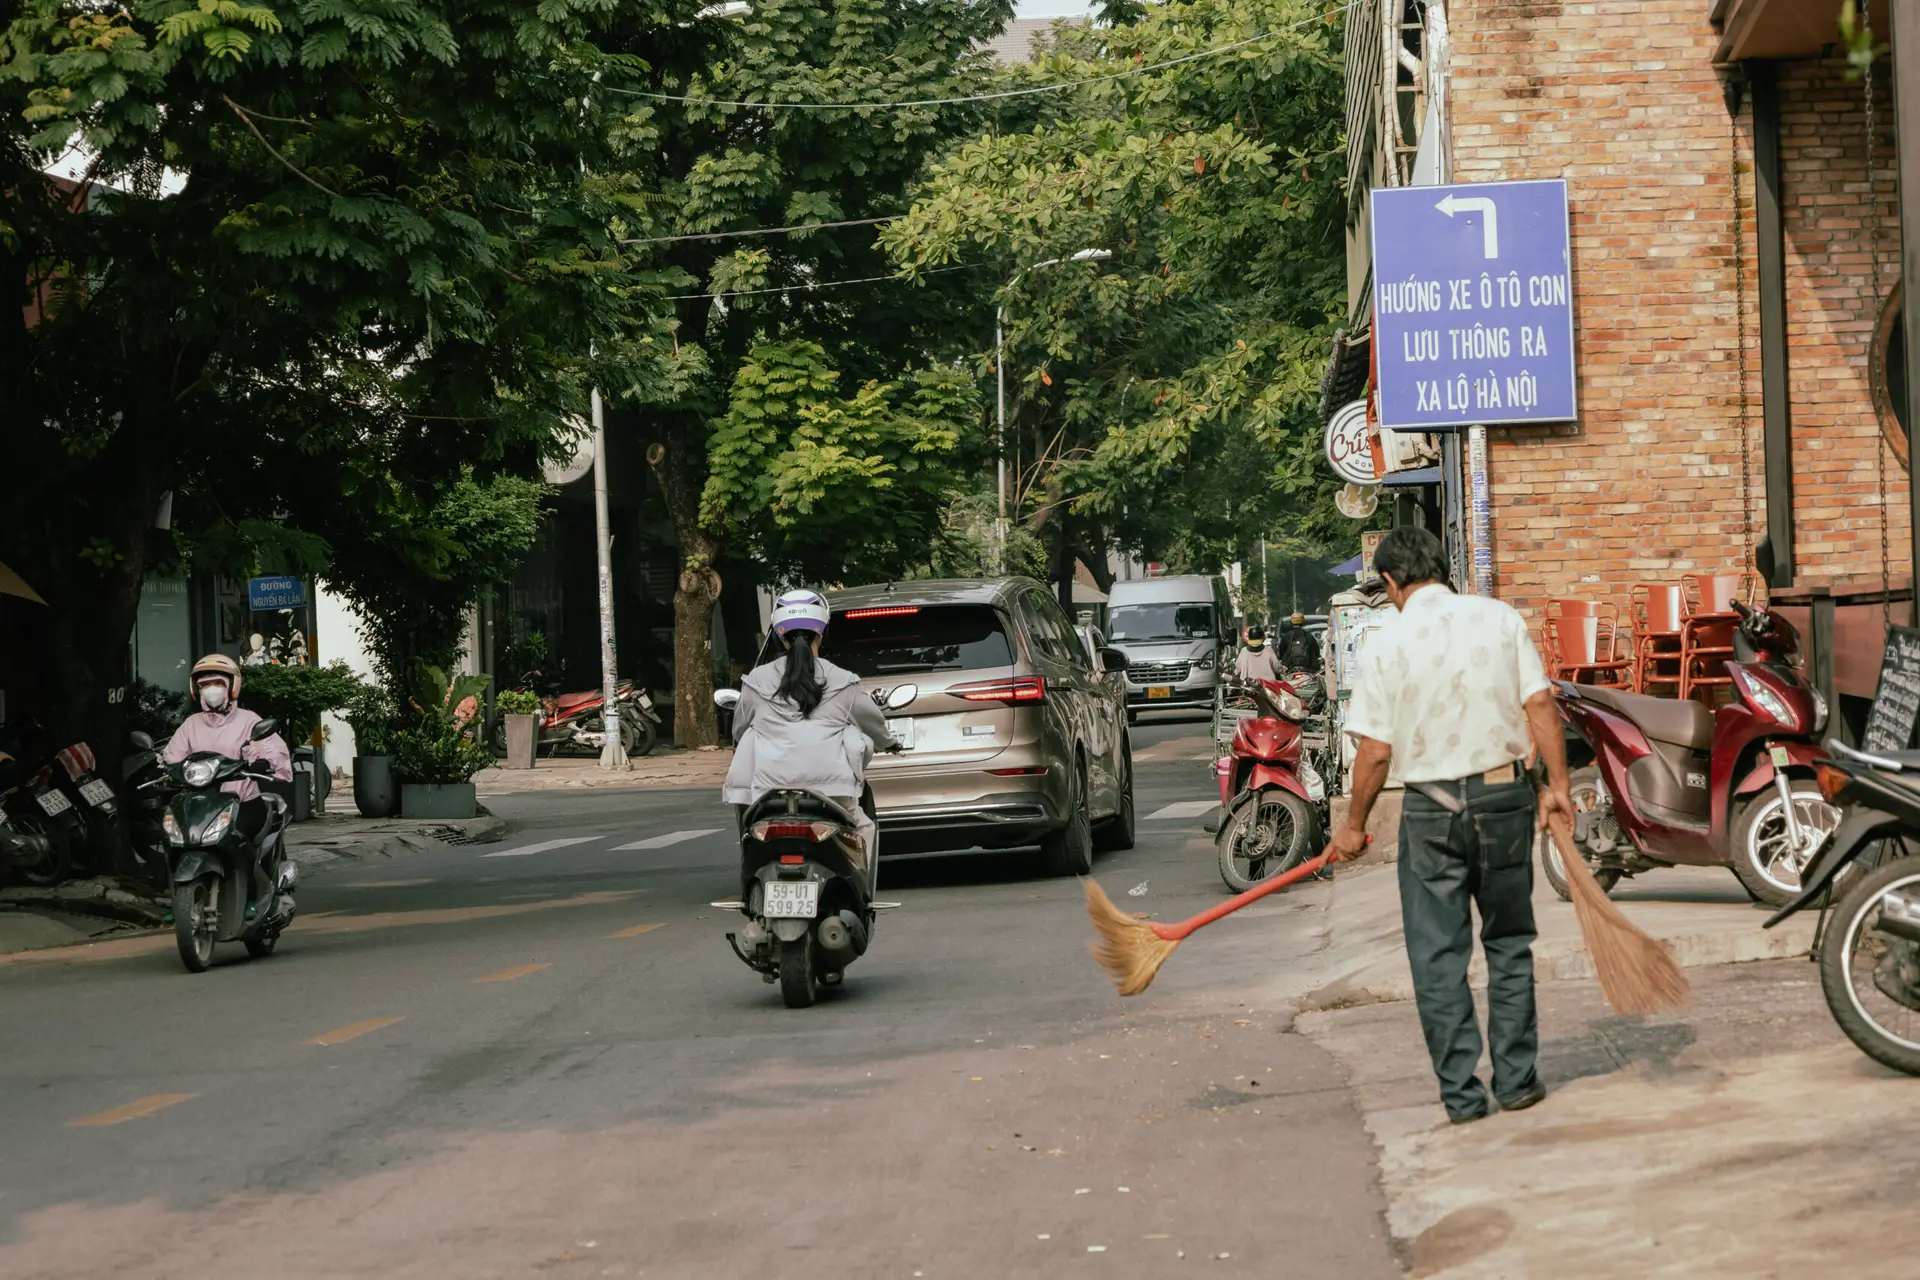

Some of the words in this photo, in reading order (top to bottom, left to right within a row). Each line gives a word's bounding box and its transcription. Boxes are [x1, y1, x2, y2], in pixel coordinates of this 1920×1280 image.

[1380, 274, 1441, 314] HƯỚNG
[1449, 279, 1472, 310] XE
[1480, 272, 1492, 308] Ô
[1497, 271, 1521, 308] TÔ
[1529, 275, 1566, 306] CON
[1403, 330, 1439, 362] LƯU
[1448, 322, 1510, 360] THÔNG
[1521, 325, 1548, 357] RA
[1416, 380, 1441, 411] XA
[1447, 372, 1469, 415] LỘ
[1476, 369, 1502, 409] HÀ
[1507, 369, 1538, 412] NỘI
[260, 580, 292, 591] ĐƯỜNG
[108, 687, 125, 704] 80
[773, 884, 808, 899] 59-U1
[767, 900, 814, 915] 599.25
